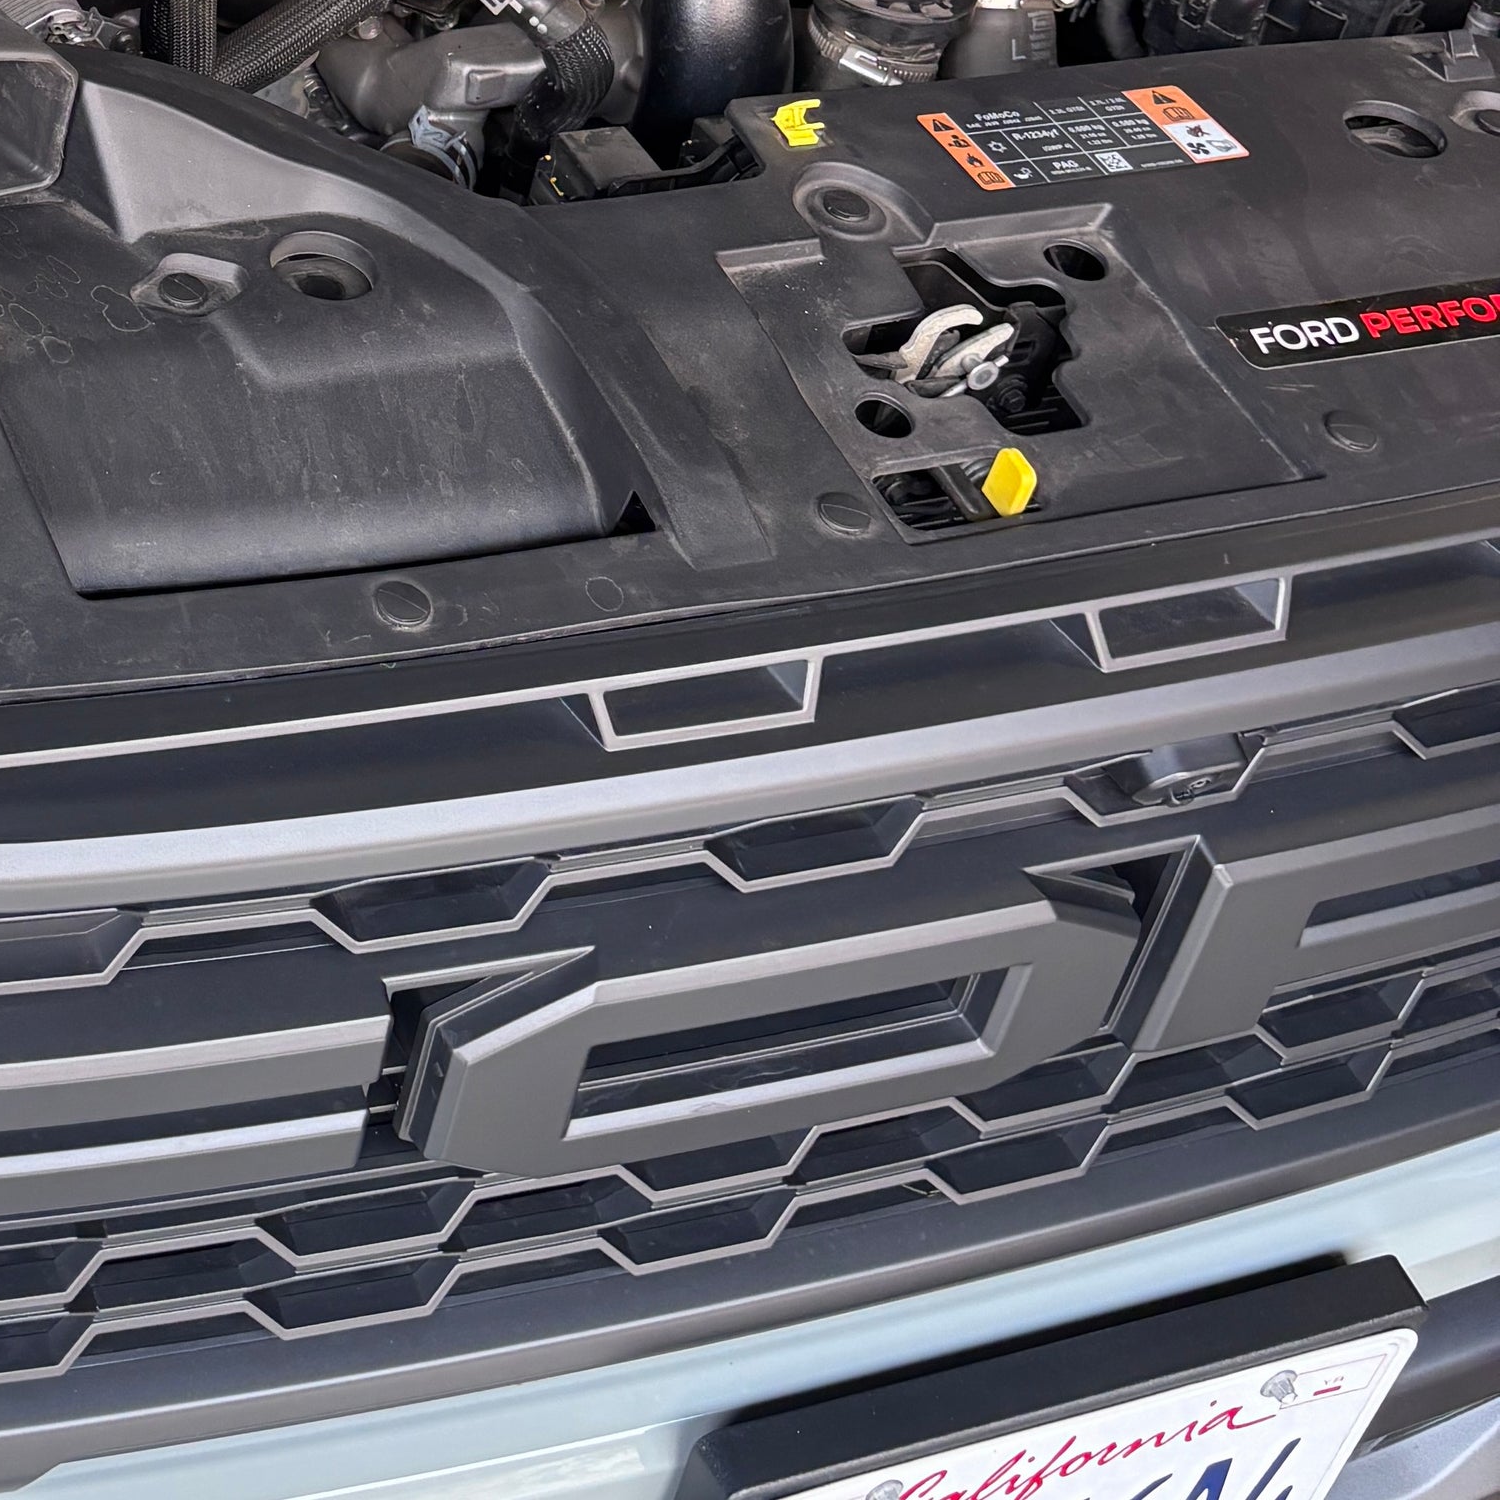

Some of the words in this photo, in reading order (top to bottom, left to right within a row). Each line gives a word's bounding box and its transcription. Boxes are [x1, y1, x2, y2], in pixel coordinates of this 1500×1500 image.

[974, 110, 1020, 122] FoMoCo
[1052, 159, 1080, 170] PAG
[1249, 316, 1360, 354] FORD
[1359, 294, 1500, 339] PERFO
